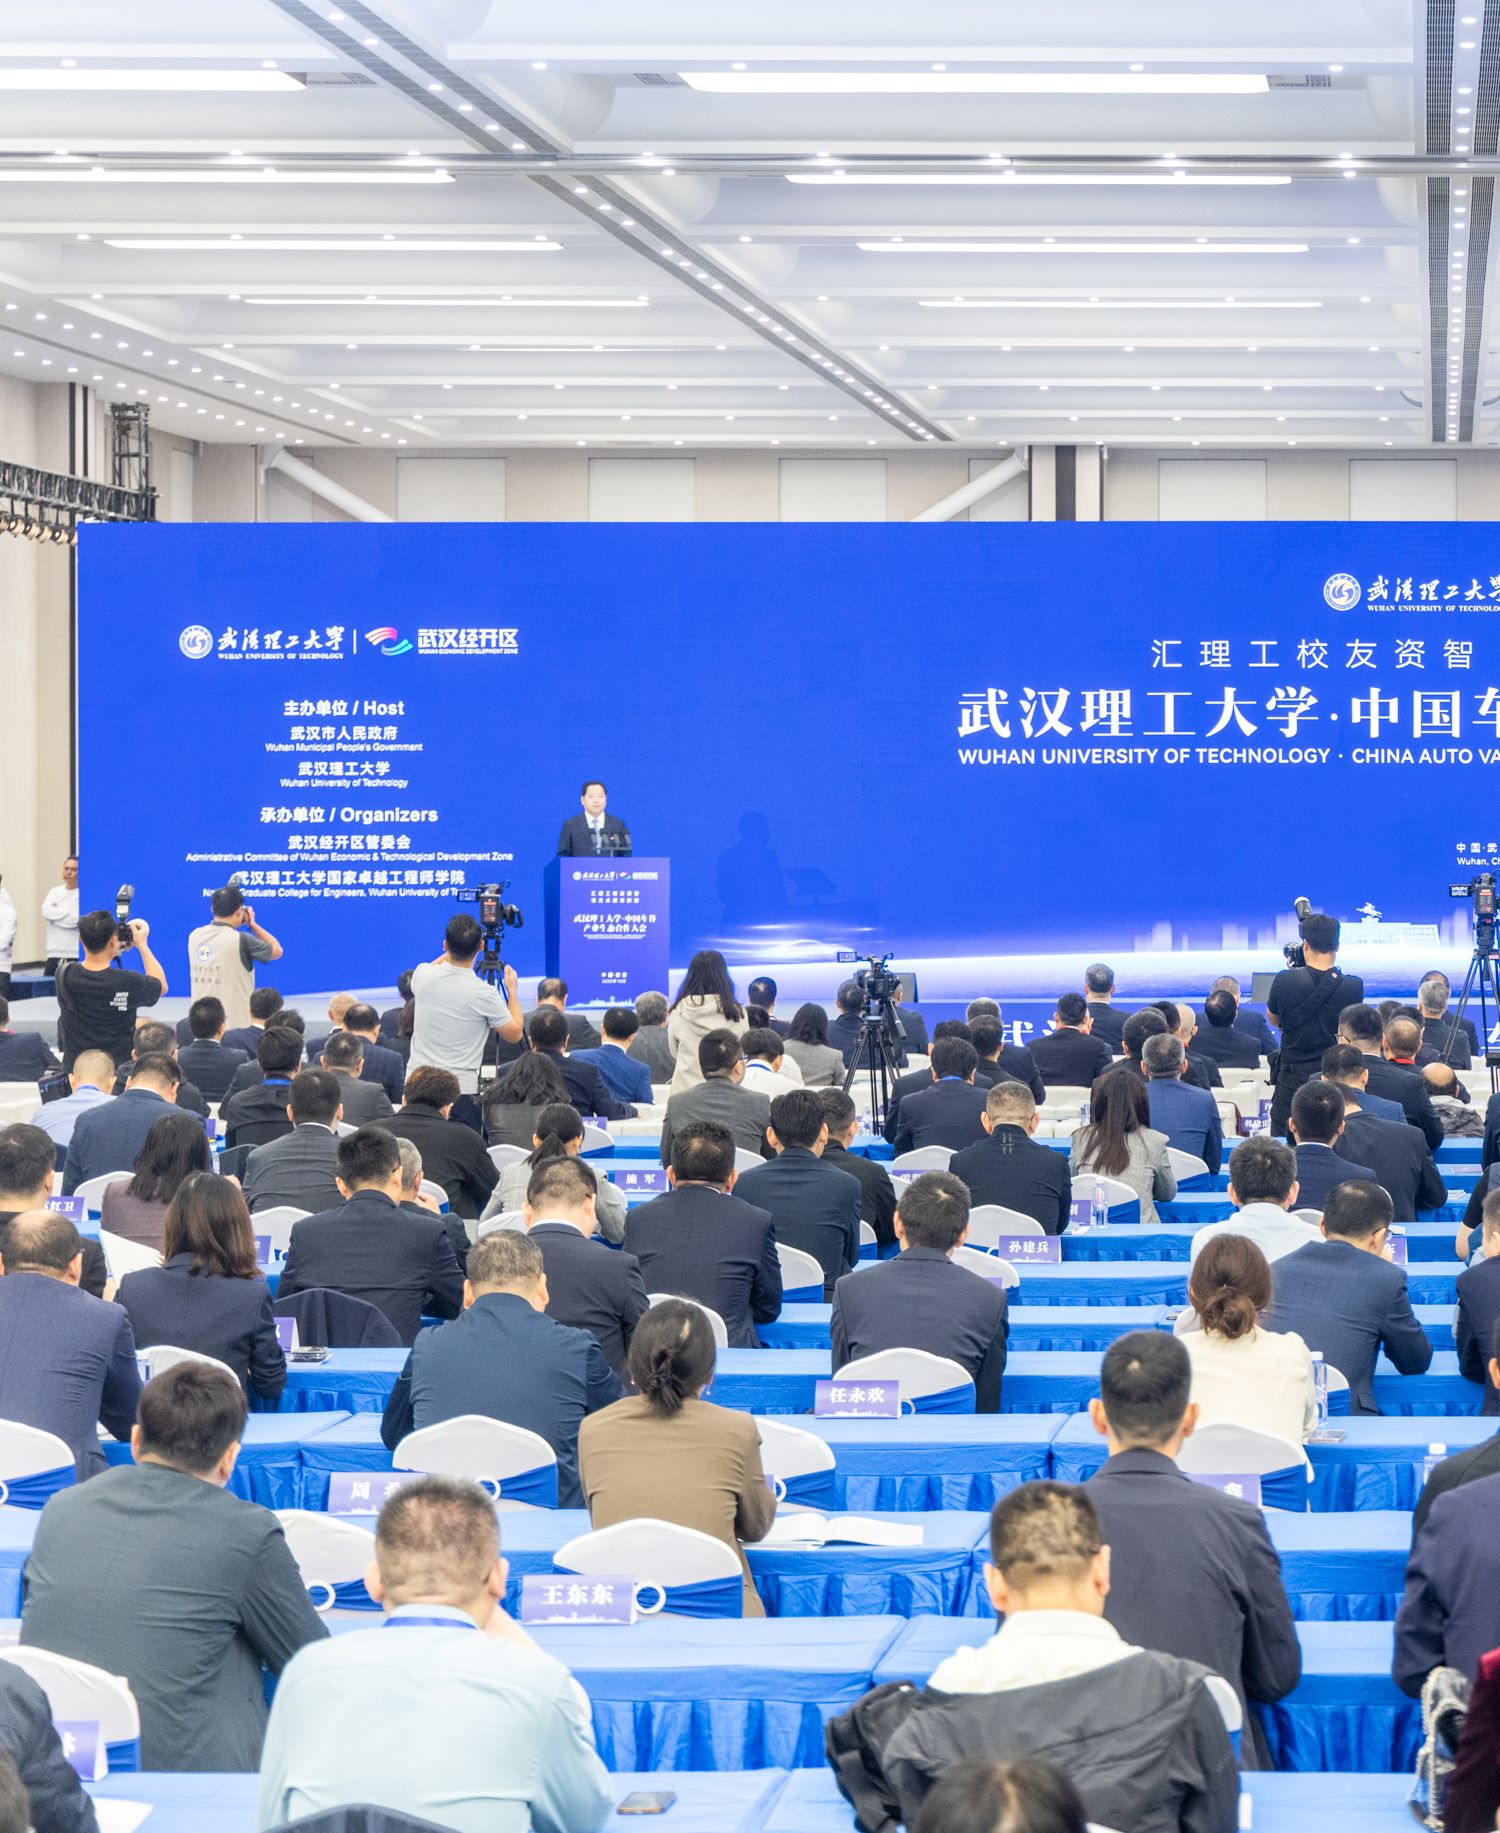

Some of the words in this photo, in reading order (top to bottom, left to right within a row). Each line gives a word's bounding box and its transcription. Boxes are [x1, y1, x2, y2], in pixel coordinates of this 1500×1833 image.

[1367, 604, 1395, 612] WUHAN
[1445, 604, 1456, 612] OF
[417, 628, 519, 649] 武汉经开区
[1151, 639, 1473, 669] 汇理工校友资智
[283, 699, 349, 717] 主办单位
[363, 700, 405, 716] Host
[290, 725, 398, 741] 武汉市人民政府
[264, 742, 295, 752] Wuhan
[295, 742, 335, 753] Municipal
[335, 742, 372, 753] People's
[372, 742, 424, 752] Government
[957, 748, 1035, 765] WUHAN
[1042, 747, 1159, 765] UNIVERSITY
[1163, 747, 1191, 764] OF
[1195, 747, 1331, 764] TECHNOLOGY
[1351, 747, 1415, 764] CHINA
[1418, 748, 1473, 765] AUTO
[298, 760, 391, 777] 武汉理工大学
[279, 778, 310, 788] Wuhan
[310, 778, 352, 789] University
[351, 778, 362, 788] of
[361, 777, 409, 789] Technology
[260, 806, 326, 824] 承办单位
[339, 806, 439, 825] Organizers
[287, 834, 411, 850] 武汉经开区管委会
[185, 852, 244, 862] Administrative
[243, 852, 290, 862] Committee
[289, 852, 300, 862] of
[299, 852, 330, 862] Wuhan
[330, 851, 372, 862] Economic
[379, 851, 436, 863] Technological
[436, 851, 491, 863] Development
[491, 851, 514, 861] Zone
[1456, 857, 1490, 866] Wuhan,
[277, 887, 310, 899] College
[309, 888, 323, 898] for
[323, 887, 367, 899] Engineers,
[367, 887, 399, 897] Wuhan
[398, 887, 440, 898] University
[440, 887, 450, 897] of
[829, 1386, 885, 1404] 任永欢
[540, 1584, 615, 1605] 王东东
